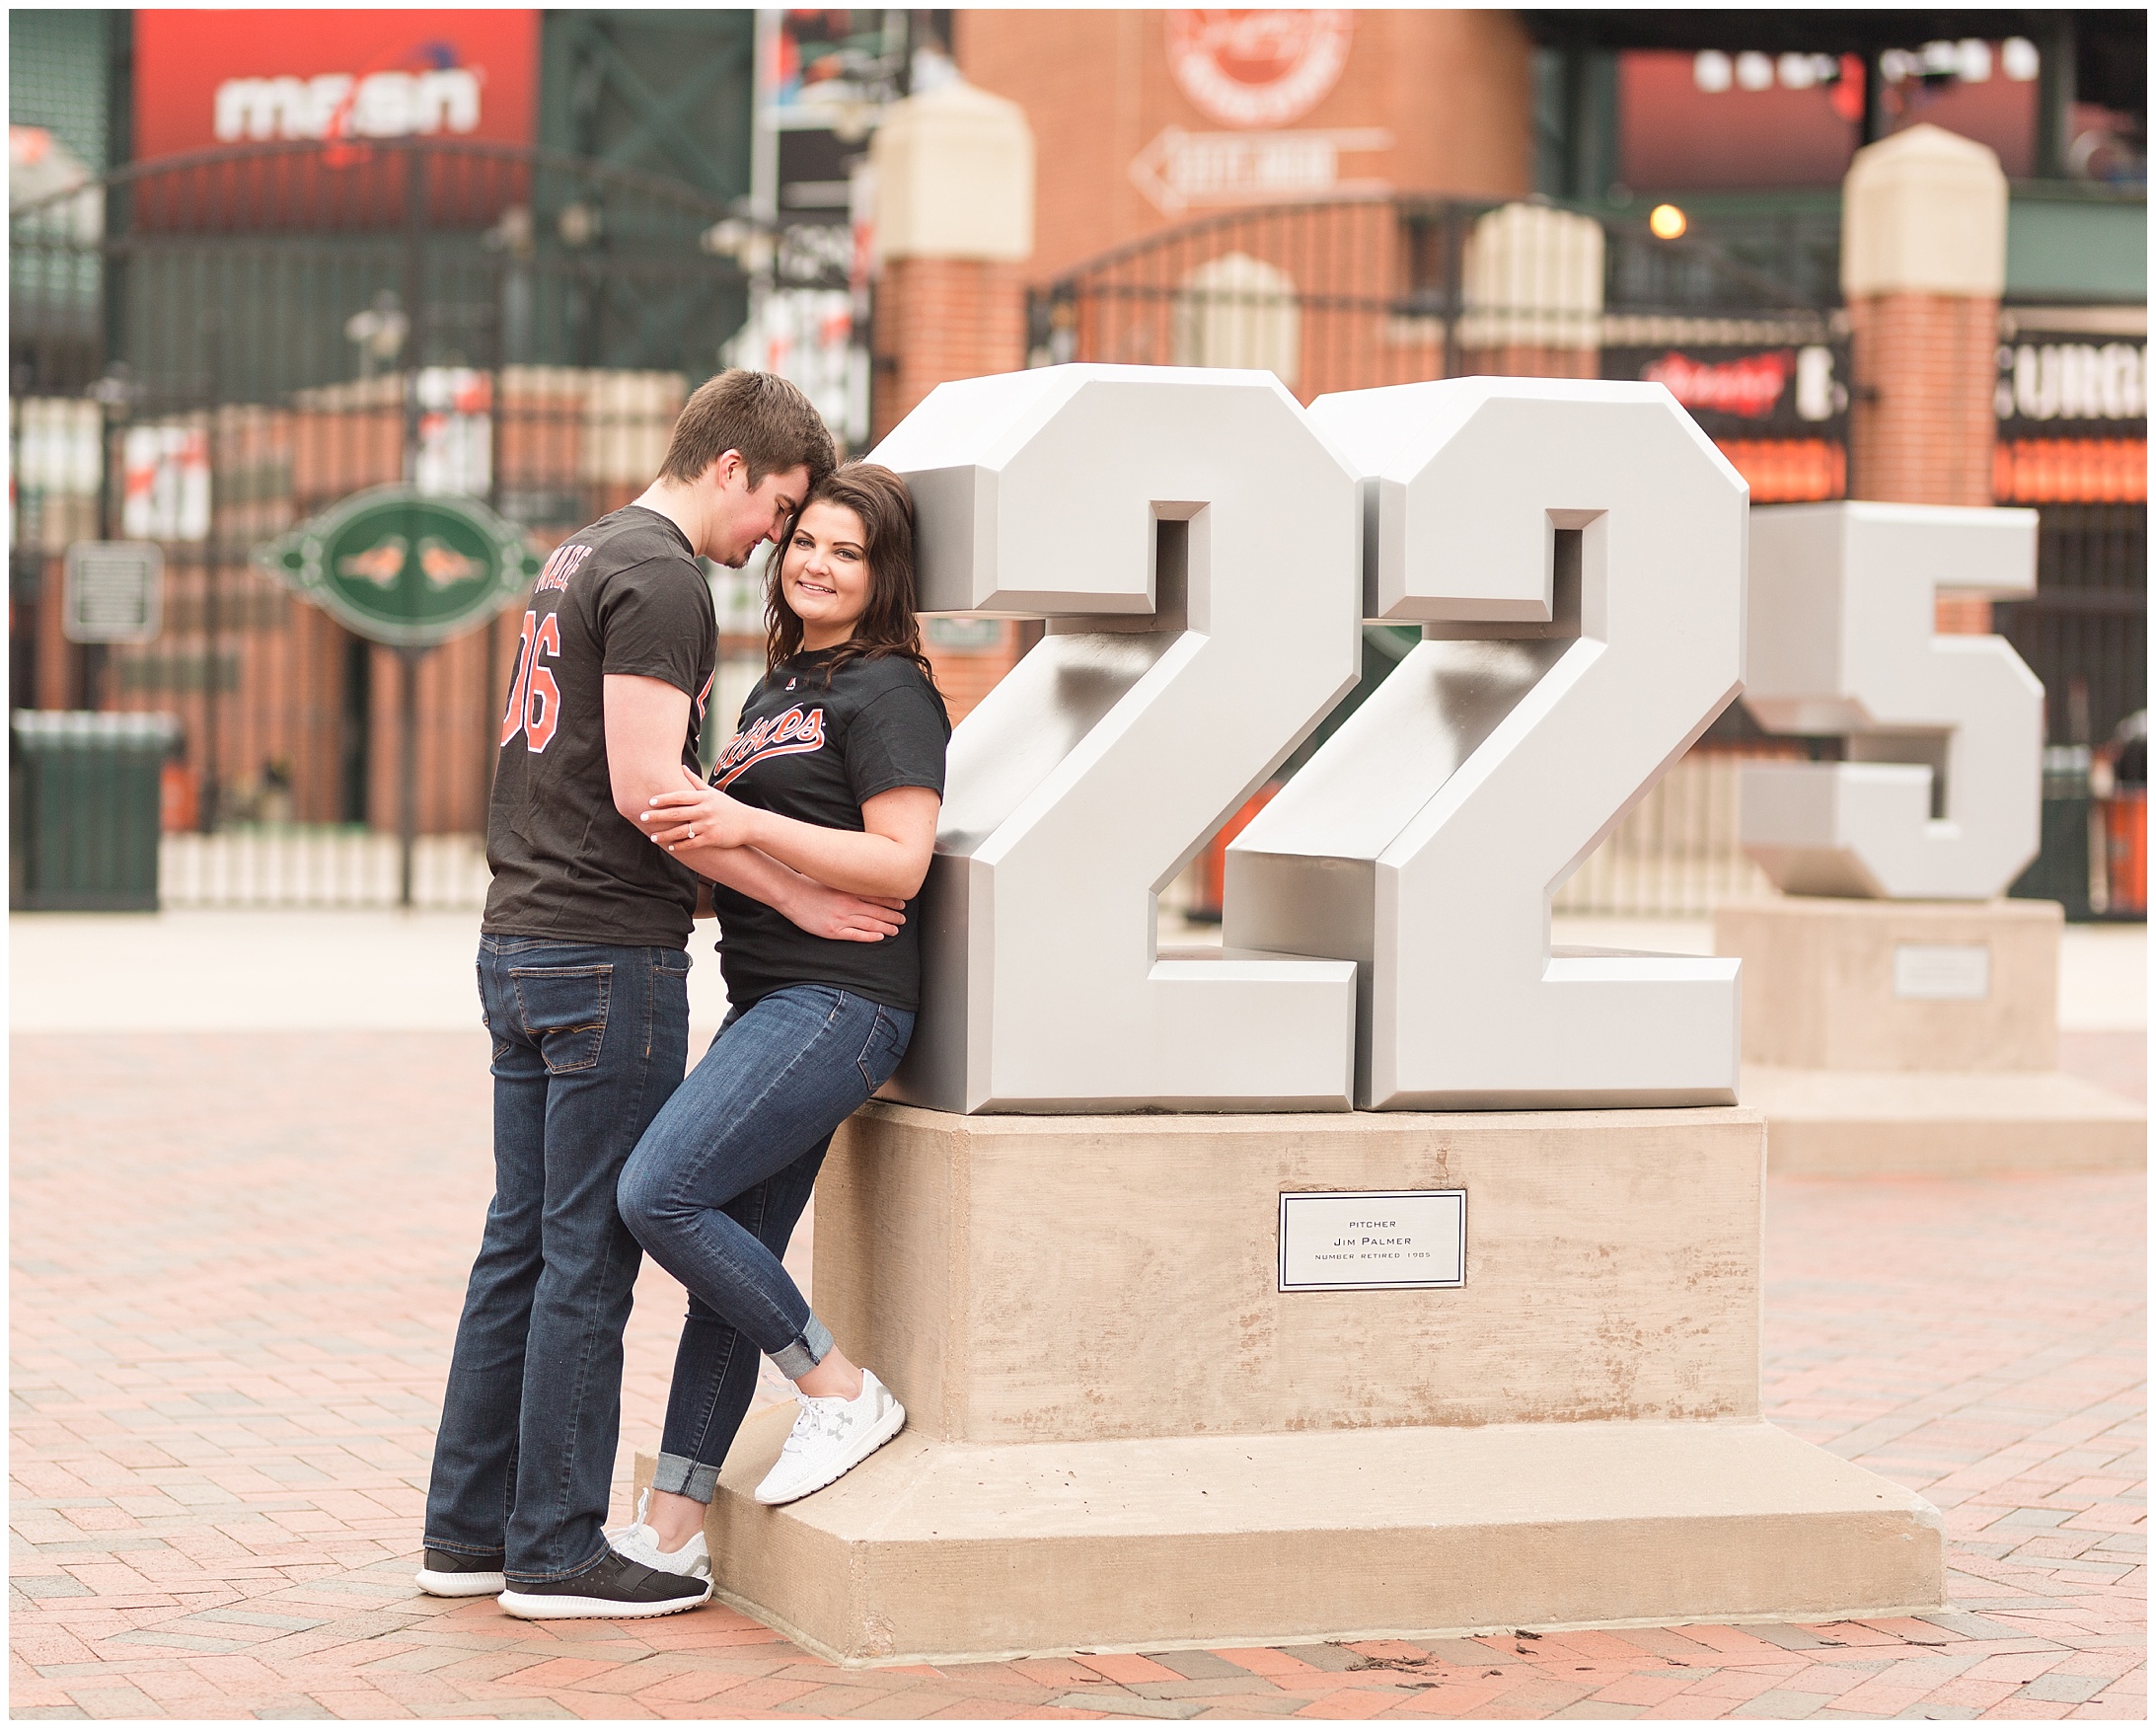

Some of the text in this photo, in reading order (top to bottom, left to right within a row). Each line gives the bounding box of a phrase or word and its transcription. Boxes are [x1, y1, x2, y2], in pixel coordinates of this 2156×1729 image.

[928, 365, 1749, 1115] 22
[1796, 501, 2046, 900] 5
[1333, 1237, 1412, 1246] JIM PALMER
